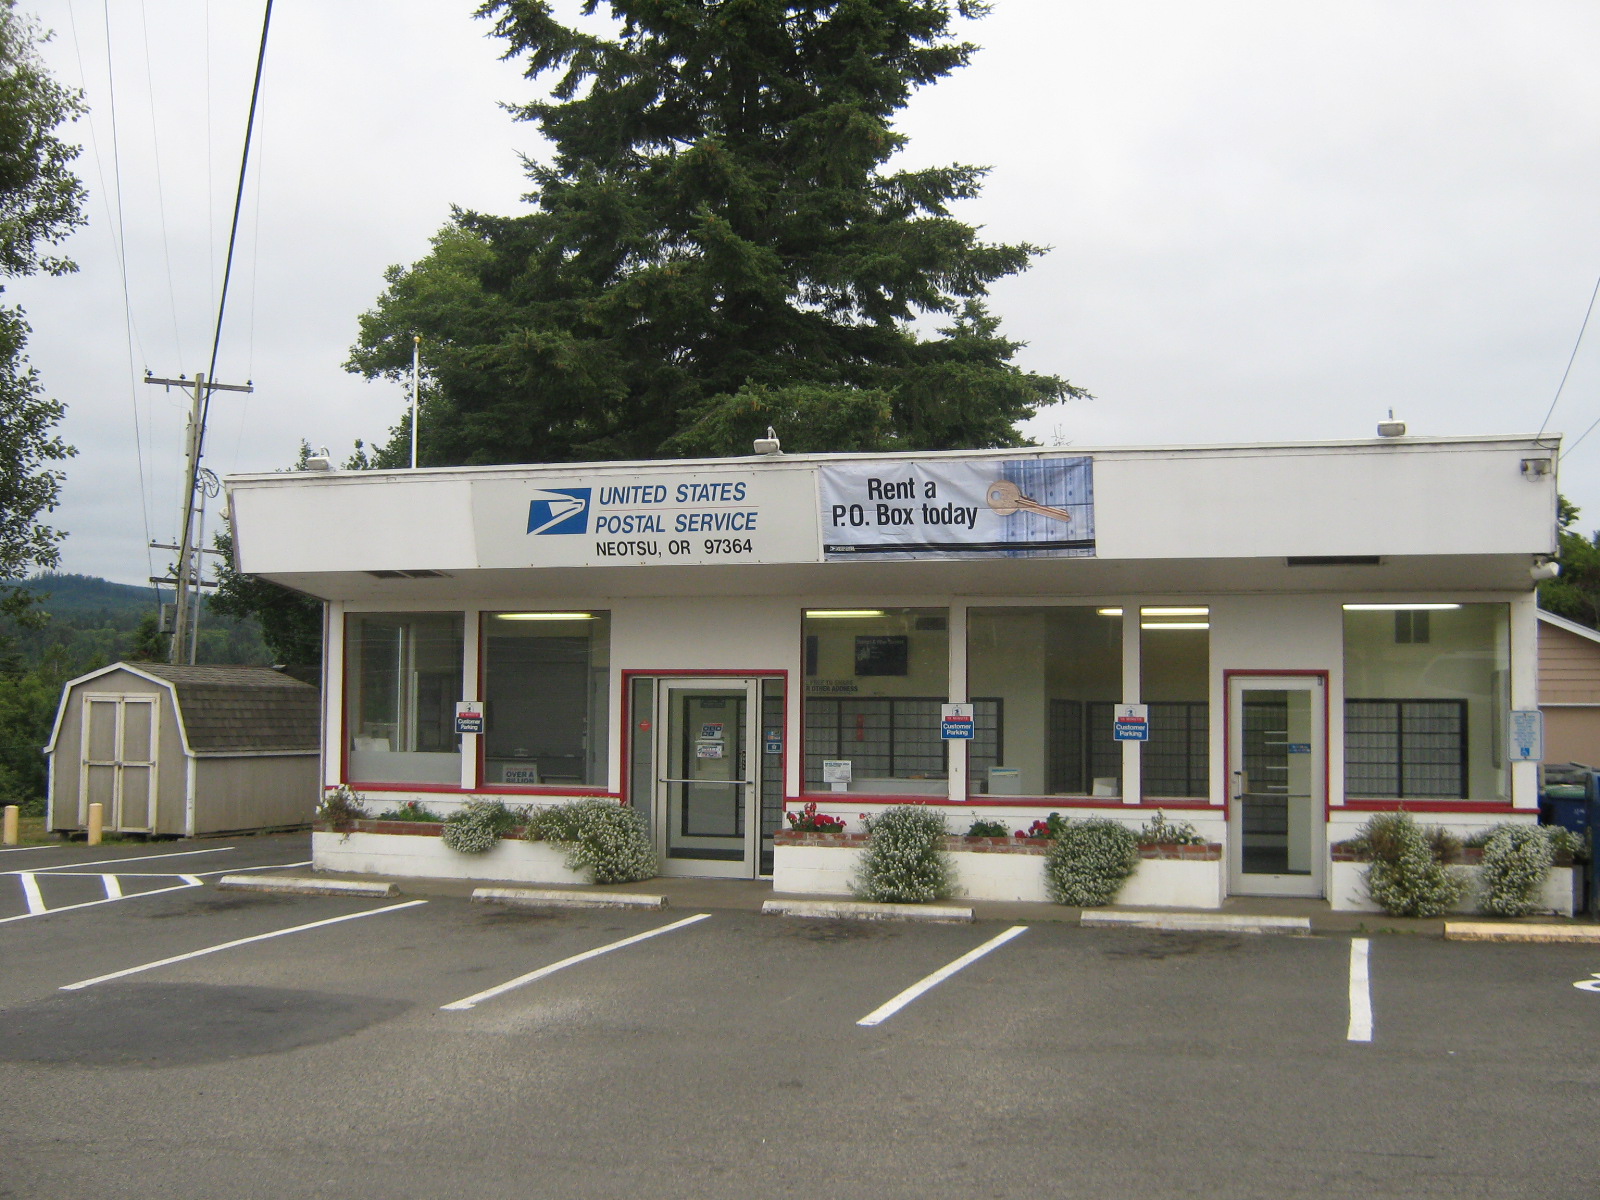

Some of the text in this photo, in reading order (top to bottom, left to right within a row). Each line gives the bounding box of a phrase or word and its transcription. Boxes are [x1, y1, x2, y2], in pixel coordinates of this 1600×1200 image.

[600, 481, 747, 505] UNITED STATES
[867, 477, 937, 501] Rent a
[595, 511, 758, 534] POSTAL SERVICE
[832, 502, 978, 530] P.O. Box today
[596, 538, 753, 558] NEOTSU, OR 97364
